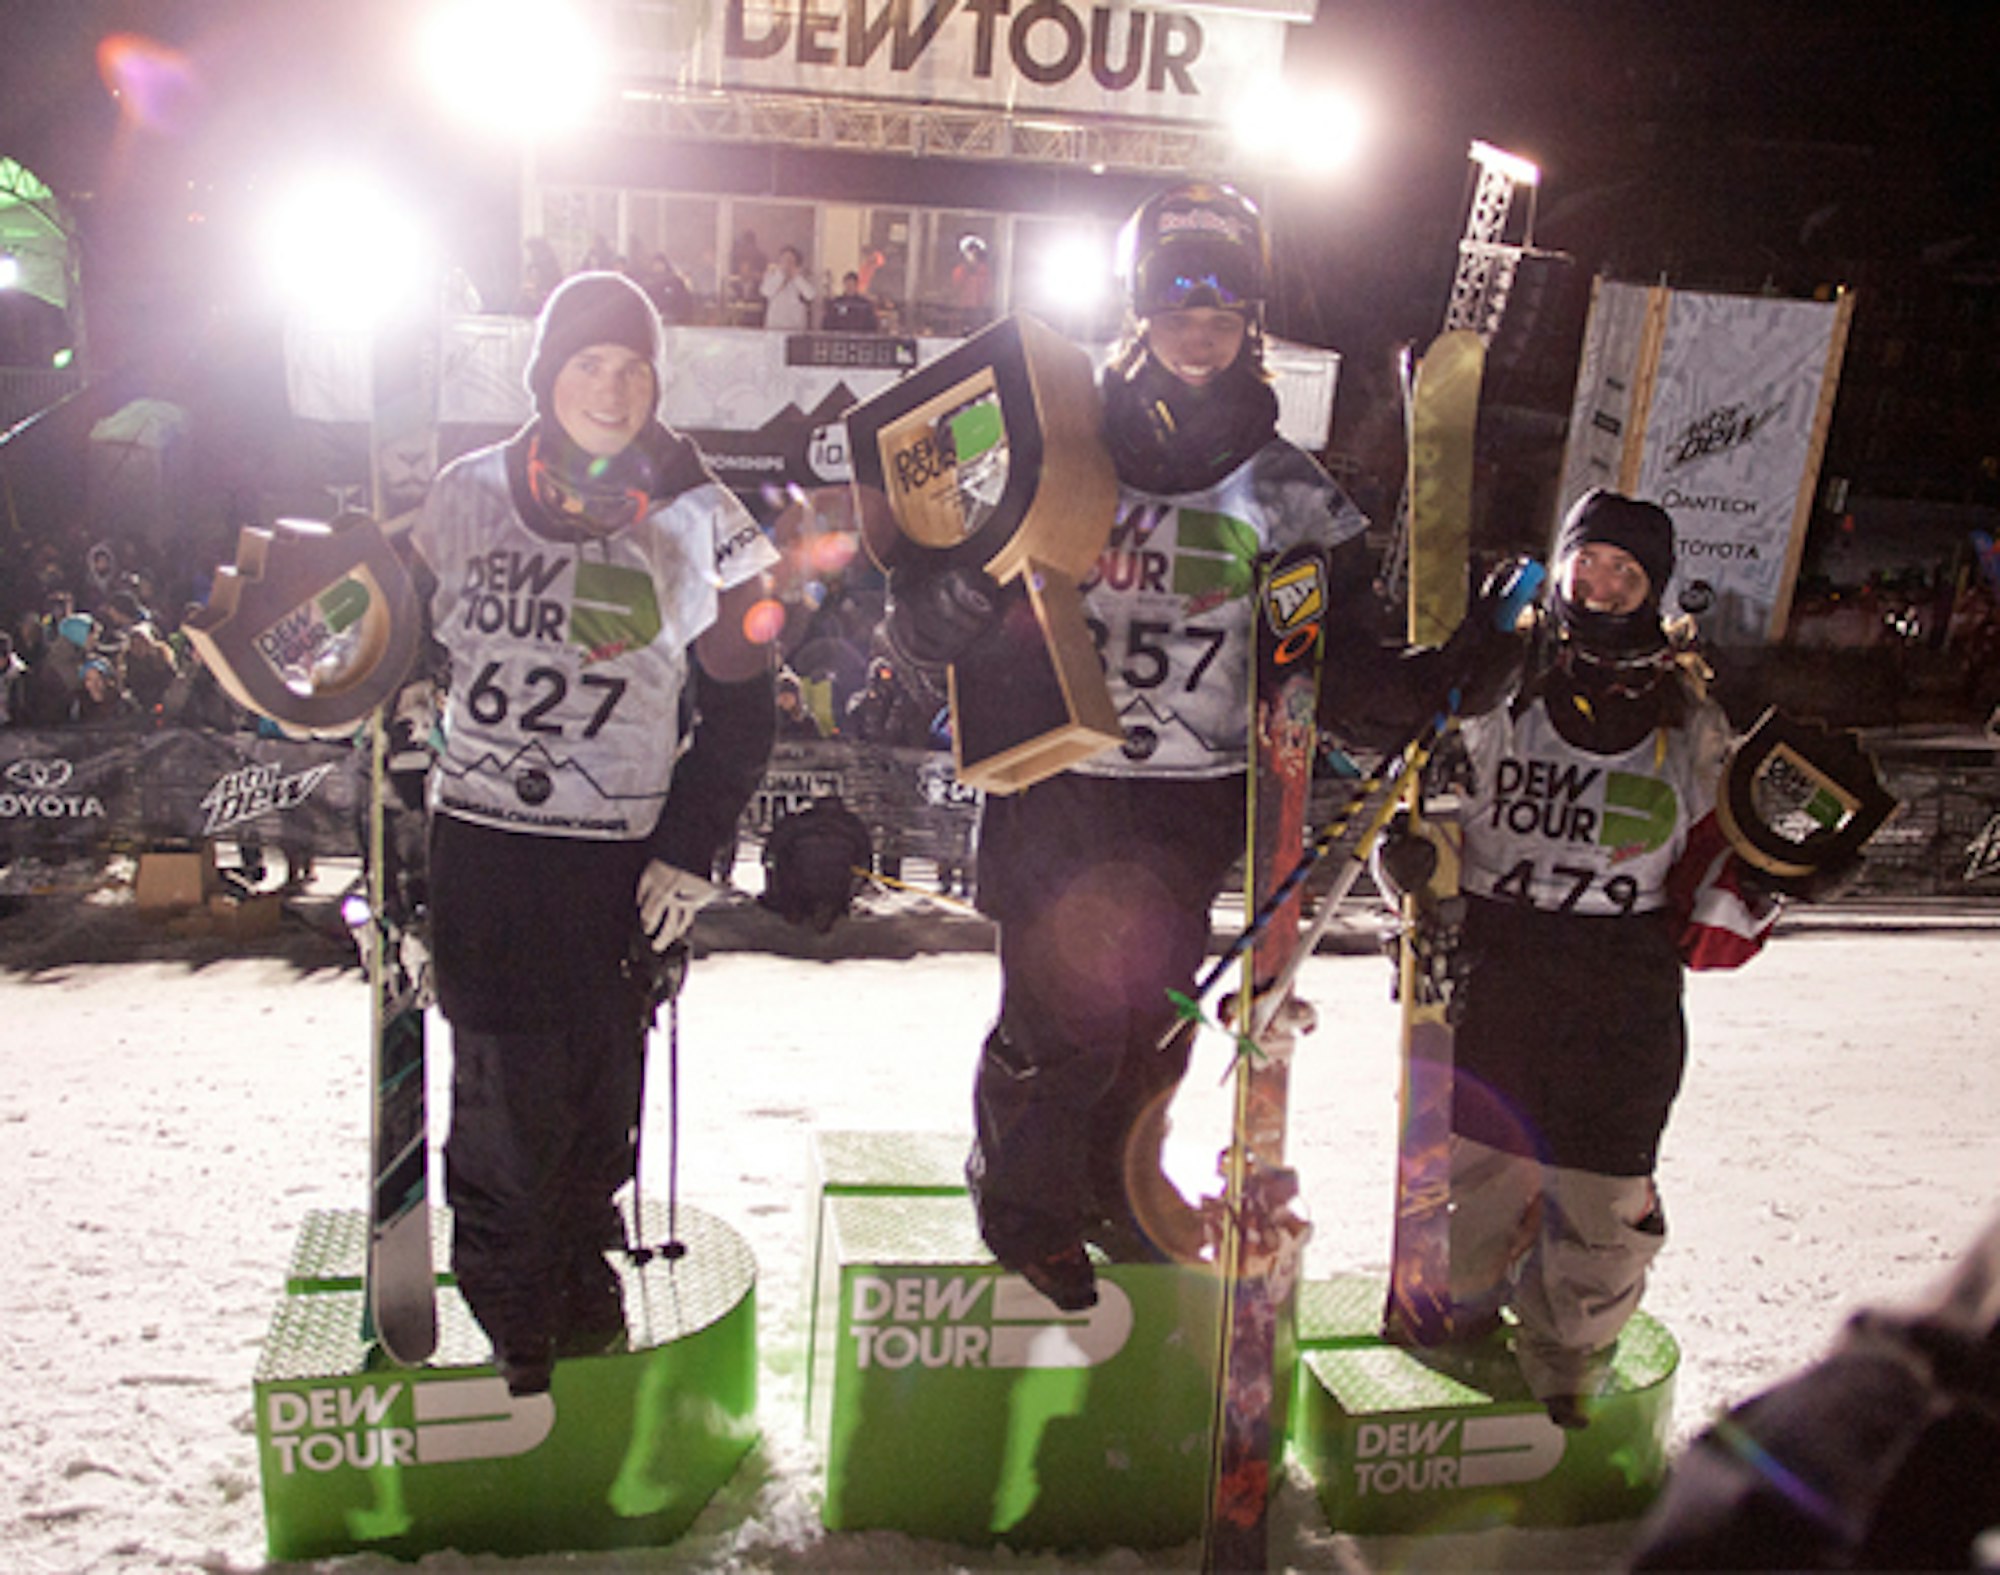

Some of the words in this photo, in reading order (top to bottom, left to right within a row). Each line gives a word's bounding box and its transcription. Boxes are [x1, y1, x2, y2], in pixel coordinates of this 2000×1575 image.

[724, 0, 952, 72] DEW
[962, 0, 1205, 95] TOUR
[1078, 551, 1168, 593] OUR
[1678, 540, 1760, 560] TOYOTA
[460, 551, 570, 597] DEW
[464, 595, 565, 642] TOUR
[469, 661, 627, 739] 627
[1497, 758, 1602, 802] DEW
[0, 794, 105, 817] OYOTA
[1491, 798, 1595, 844] TOUR
[1493, 858, 1638, 917] 479
[853, 1275, 993, 1321] DEW
[851, 1325, 990, 1369] TOUR
[268, 1381, 403, 1433] DEW
[271, 1427, 417, 1475] TOUR
[1357, 1419, 1458, 1458] DEW
[1354, 1456, 1459, 1497] TOUR
